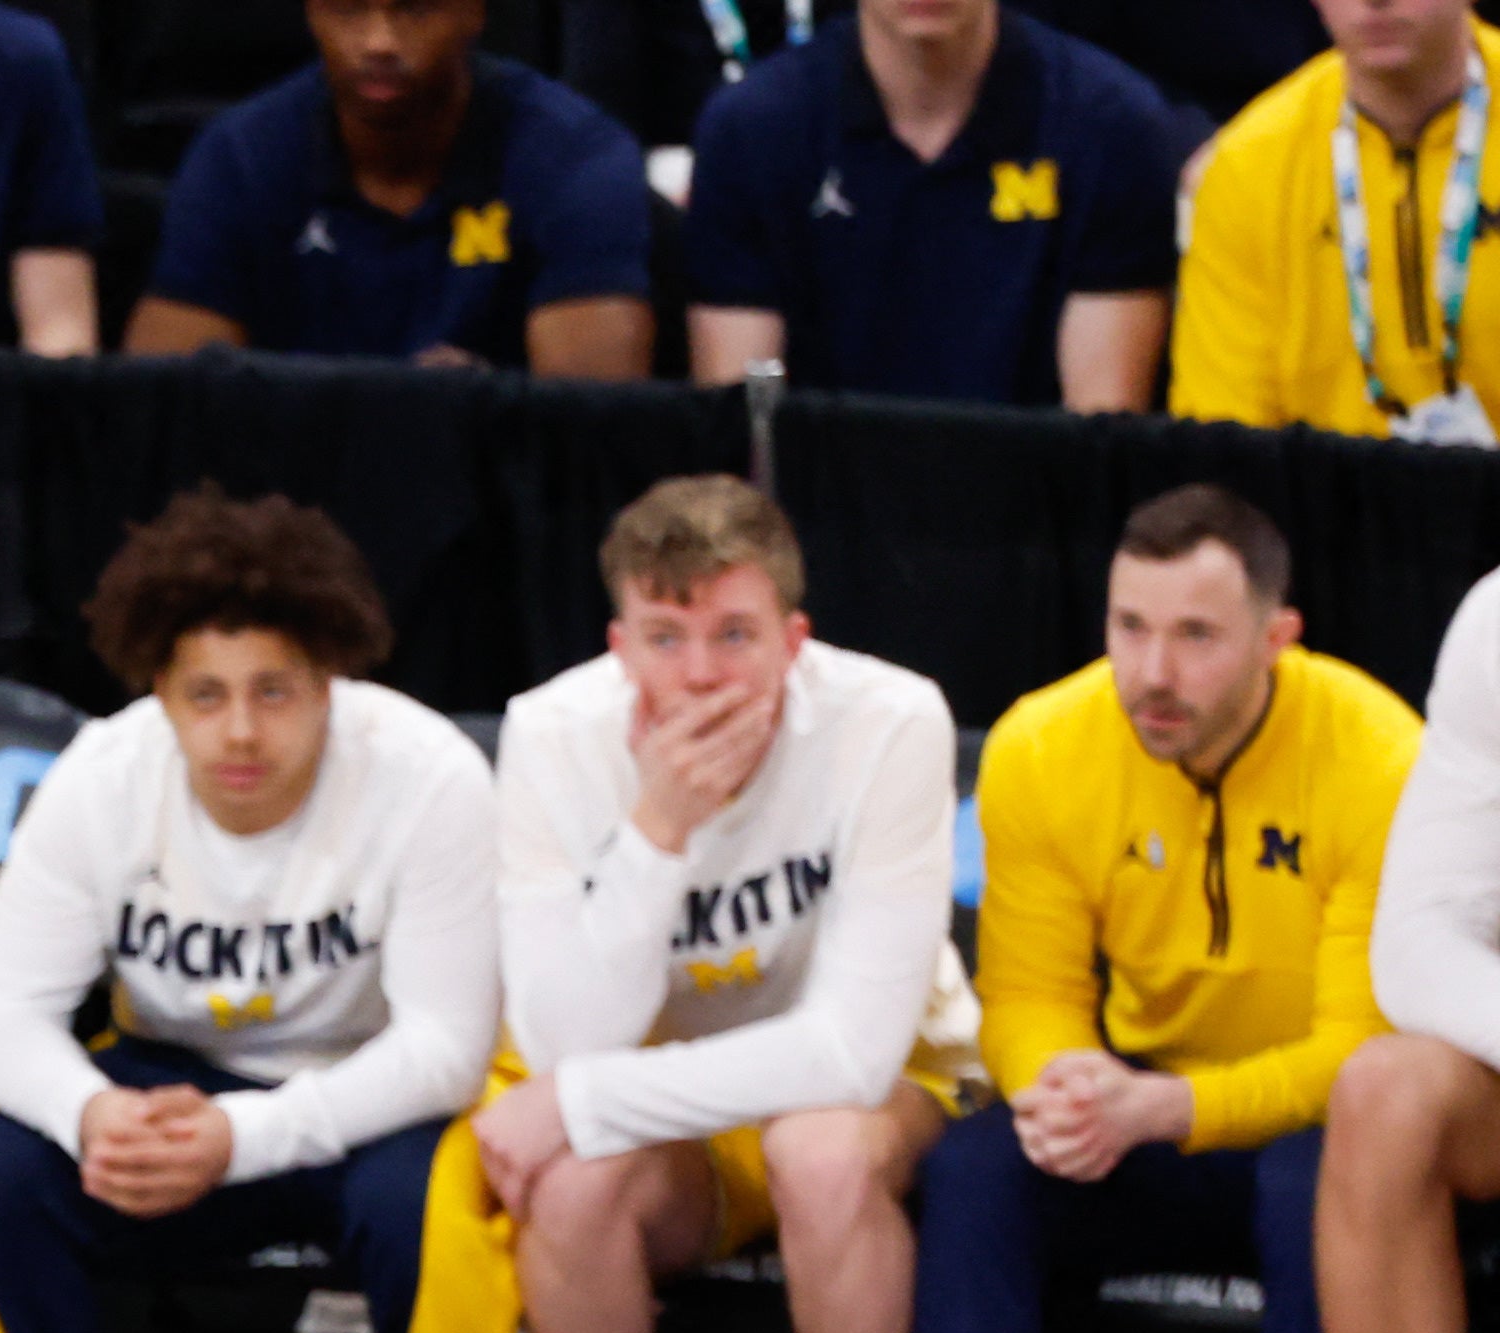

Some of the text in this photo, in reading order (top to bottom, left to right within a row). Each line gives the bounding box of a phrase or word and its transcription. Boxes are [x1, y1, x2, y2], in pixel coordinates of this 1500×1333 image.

[990, 158, 1058, 222] M
[450, 203, 509, 266] M
[1256, 826, 1304, 877] M
